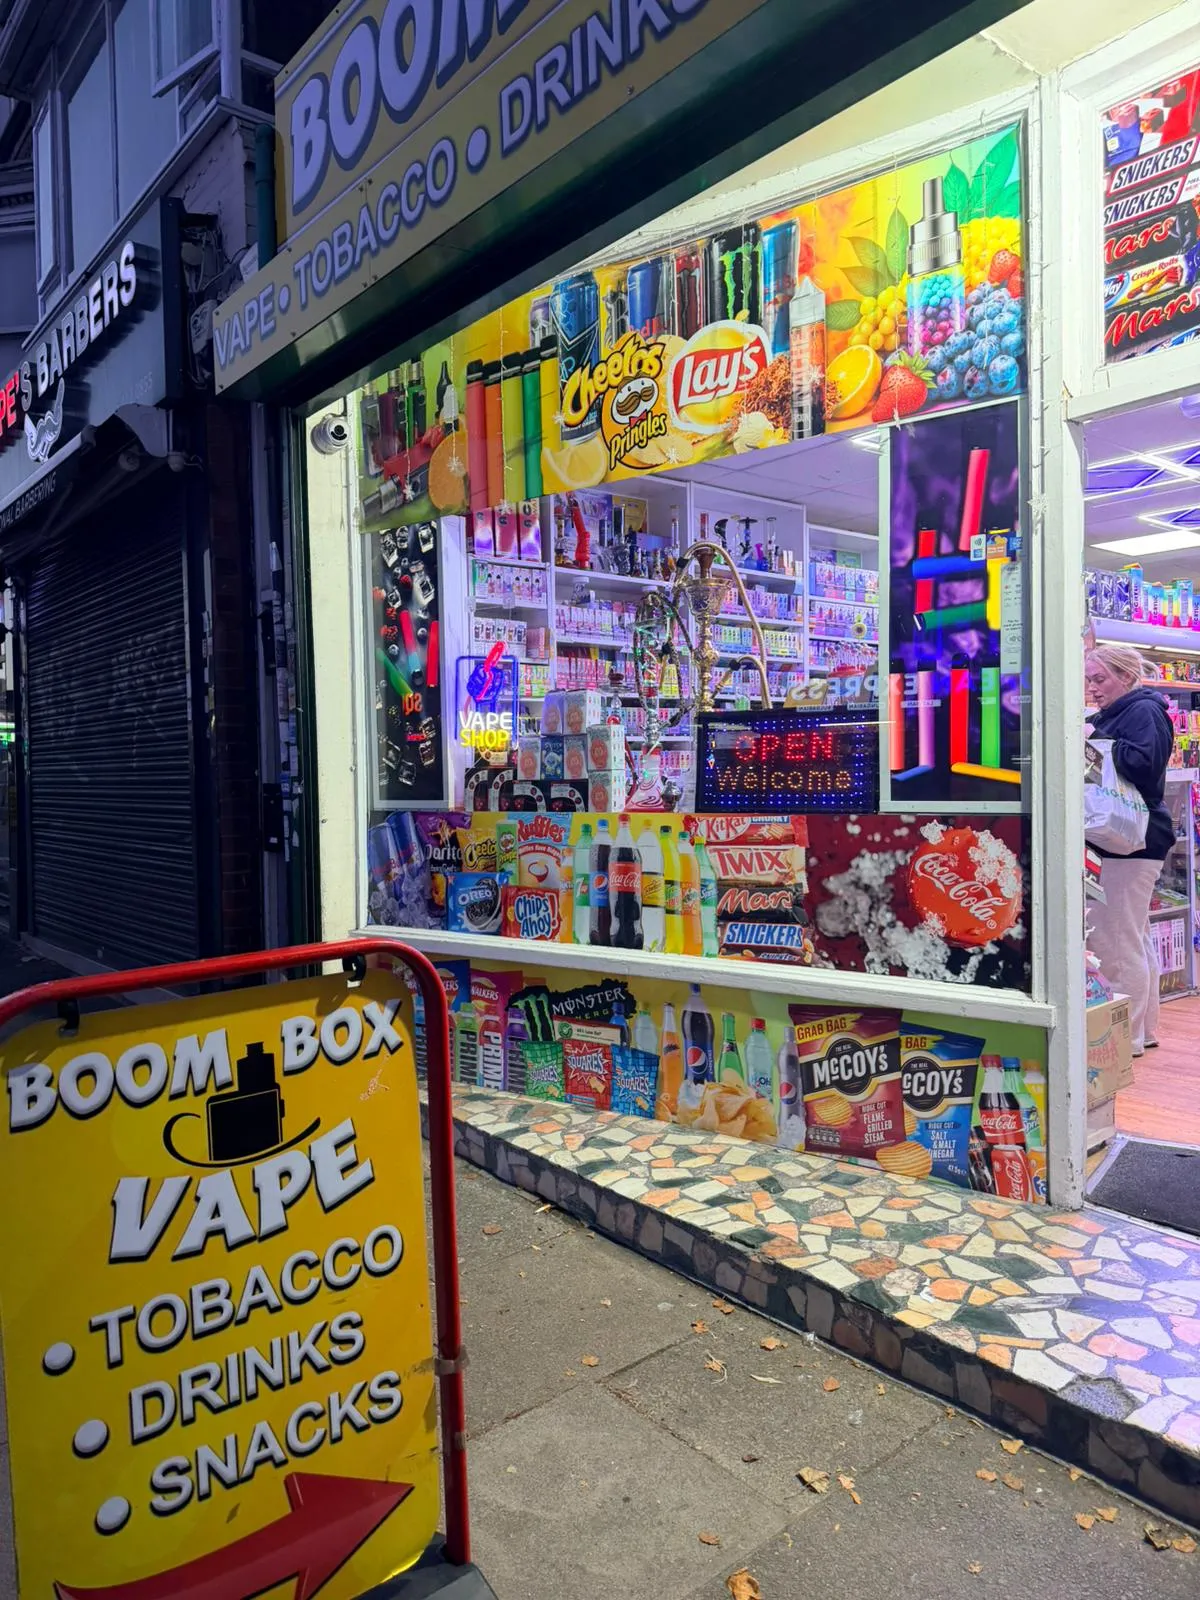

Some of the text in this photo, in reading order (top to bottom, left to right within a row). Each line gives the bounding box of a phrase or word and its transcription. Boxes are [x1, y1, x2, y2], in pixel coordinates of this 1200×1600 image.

[1113, 139, 1194, 190] SNICKERS
[1104, 180, 1180, 227] SNICKERS
[214, 281, 276, 371] VAPE
[293, 136, 458, 309] TOBACCO
[1131, 256, 1179, 283] Crispy Rolls
[36, 239, 137, 399] BARBERS
[1104, 285, 1200, 348] Mars
[562, 333, 667, 428] Cheetos
[678, 338, 767, 406] Lay's
[608, 412, 668, 472] Pringles
[458, 711, 514, 730] VAPE
[459, 728, 511, 748] SHOP
[735, 731, 834, 762] OPEN
[715, 765, 852, 791] Welcome
[704, 816, 747, 840] KitKat
[709, 847, 788, 878] TWIX
[458, 888, 493, 906] OREO
[914, 852, 1008, 923] Coca-Cola
[515, 894, 549, 923] Chips
[726, 922, 803, 948] SNICKERS
[796, 1017, 848, 1040] GRAB BAG
[905, 1036, 927, 1049] BAG
[7, 1026, 233, 1133] BOOM
[281, 1000, 405, 1076] BOX
[567, 1051, 605, 1075] SQUARES
[863, 1111, 885, 1125] FLAME
[877, 1101, 887, 1110] CUT
[864, 1131, 886, 1145] STEAK
[867, 1119, 893, 1134] GRILLED
[930, 1130, 948, 1141] SALT
[108, 1118, 376, 1263] VAPE
[89, 1223, 405, 1369] TOBACCO
[128, 1310, 367, 1447] DRINKS
[149, 1369, 405, 1517] SNACKS
